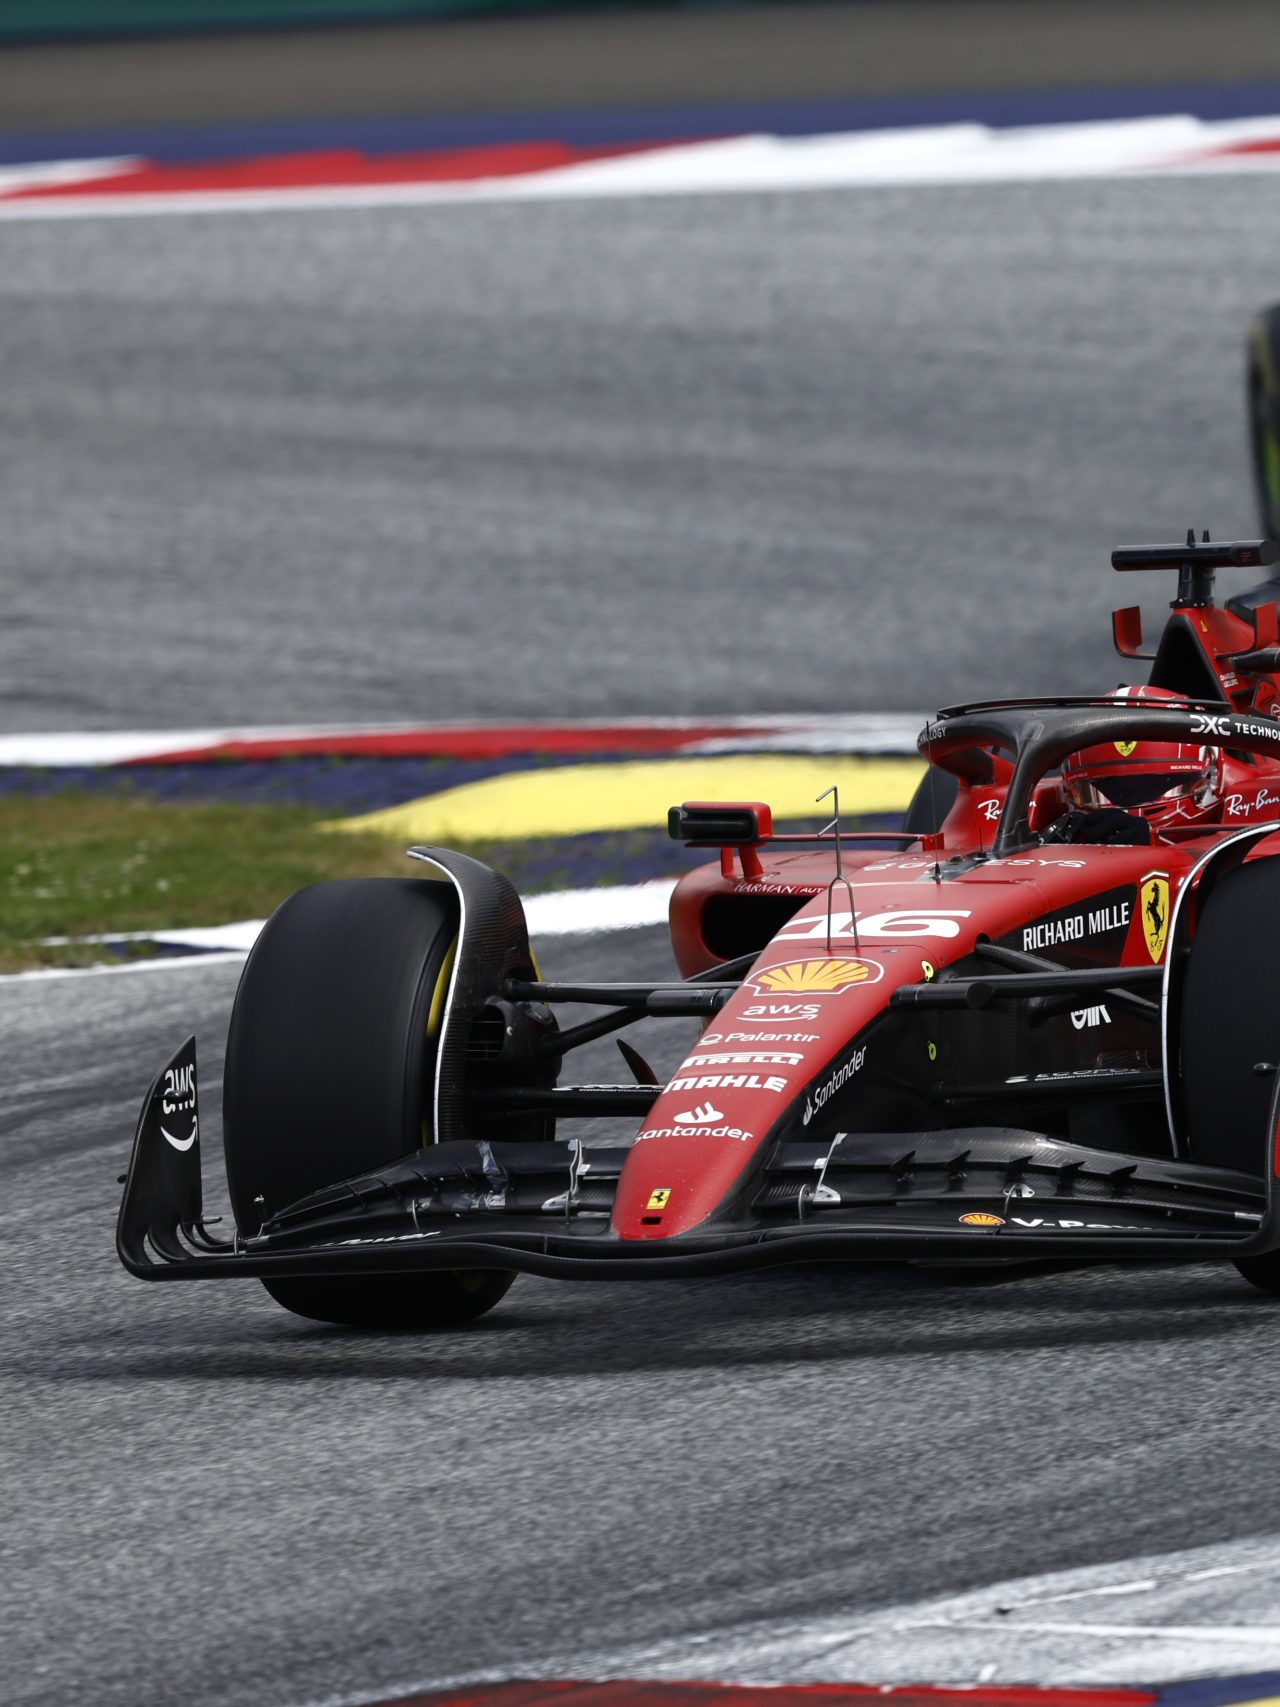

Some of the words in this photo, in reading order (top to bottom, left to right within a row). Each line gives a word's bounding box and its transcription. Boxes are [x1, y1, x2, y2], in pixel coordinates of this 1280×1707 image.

[1189, 714, 1232, 736] DXC
[1225, 788, 1280, 816] Ray-Ban
[734, 882, 796, 895] HARMAN
[768, 910, 972, 945] 16
[1023, 914, 1084, 951] RICHARD
[1088, 901, 1131, 936] MILLE
[743, 1004, 822, 1016] aws
[724, 1031, 821, 1043] Palantir
[678, 1051, 805, 1070] PIRELLI
[661, 1074, 789, 1095] MAHLE
[812, 1044, 867, 1115] Santander
[632, 1125, 754, 1146] Santander
